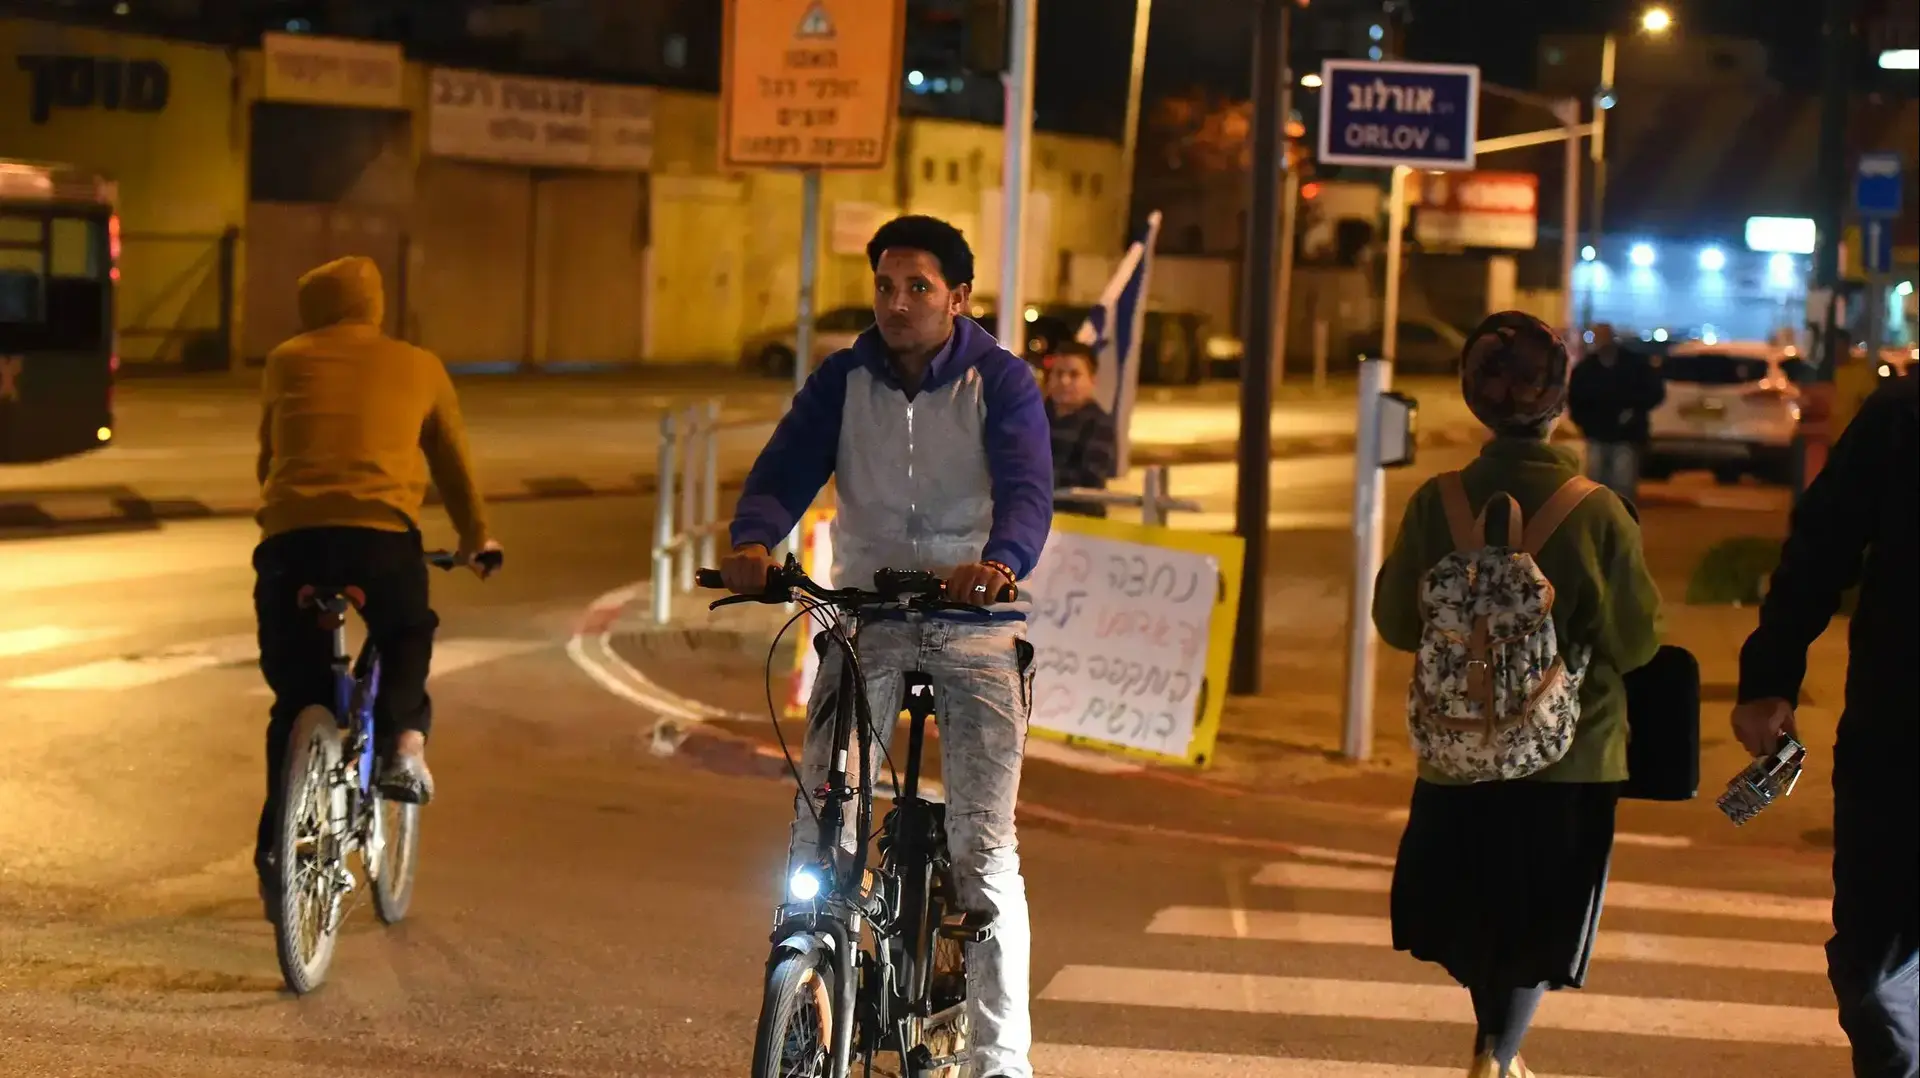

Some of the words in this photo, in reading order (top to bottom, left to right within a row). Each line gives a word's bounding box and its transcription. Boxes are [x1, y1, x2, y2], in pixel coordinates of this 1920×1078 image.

[16, 54, 169, 124] מוסך
[1346, 78, 1435, 114] אורלוב
[1344, 123, 1430, 150] ORLOV
[1107, 554, 1199, 603] נחצה
